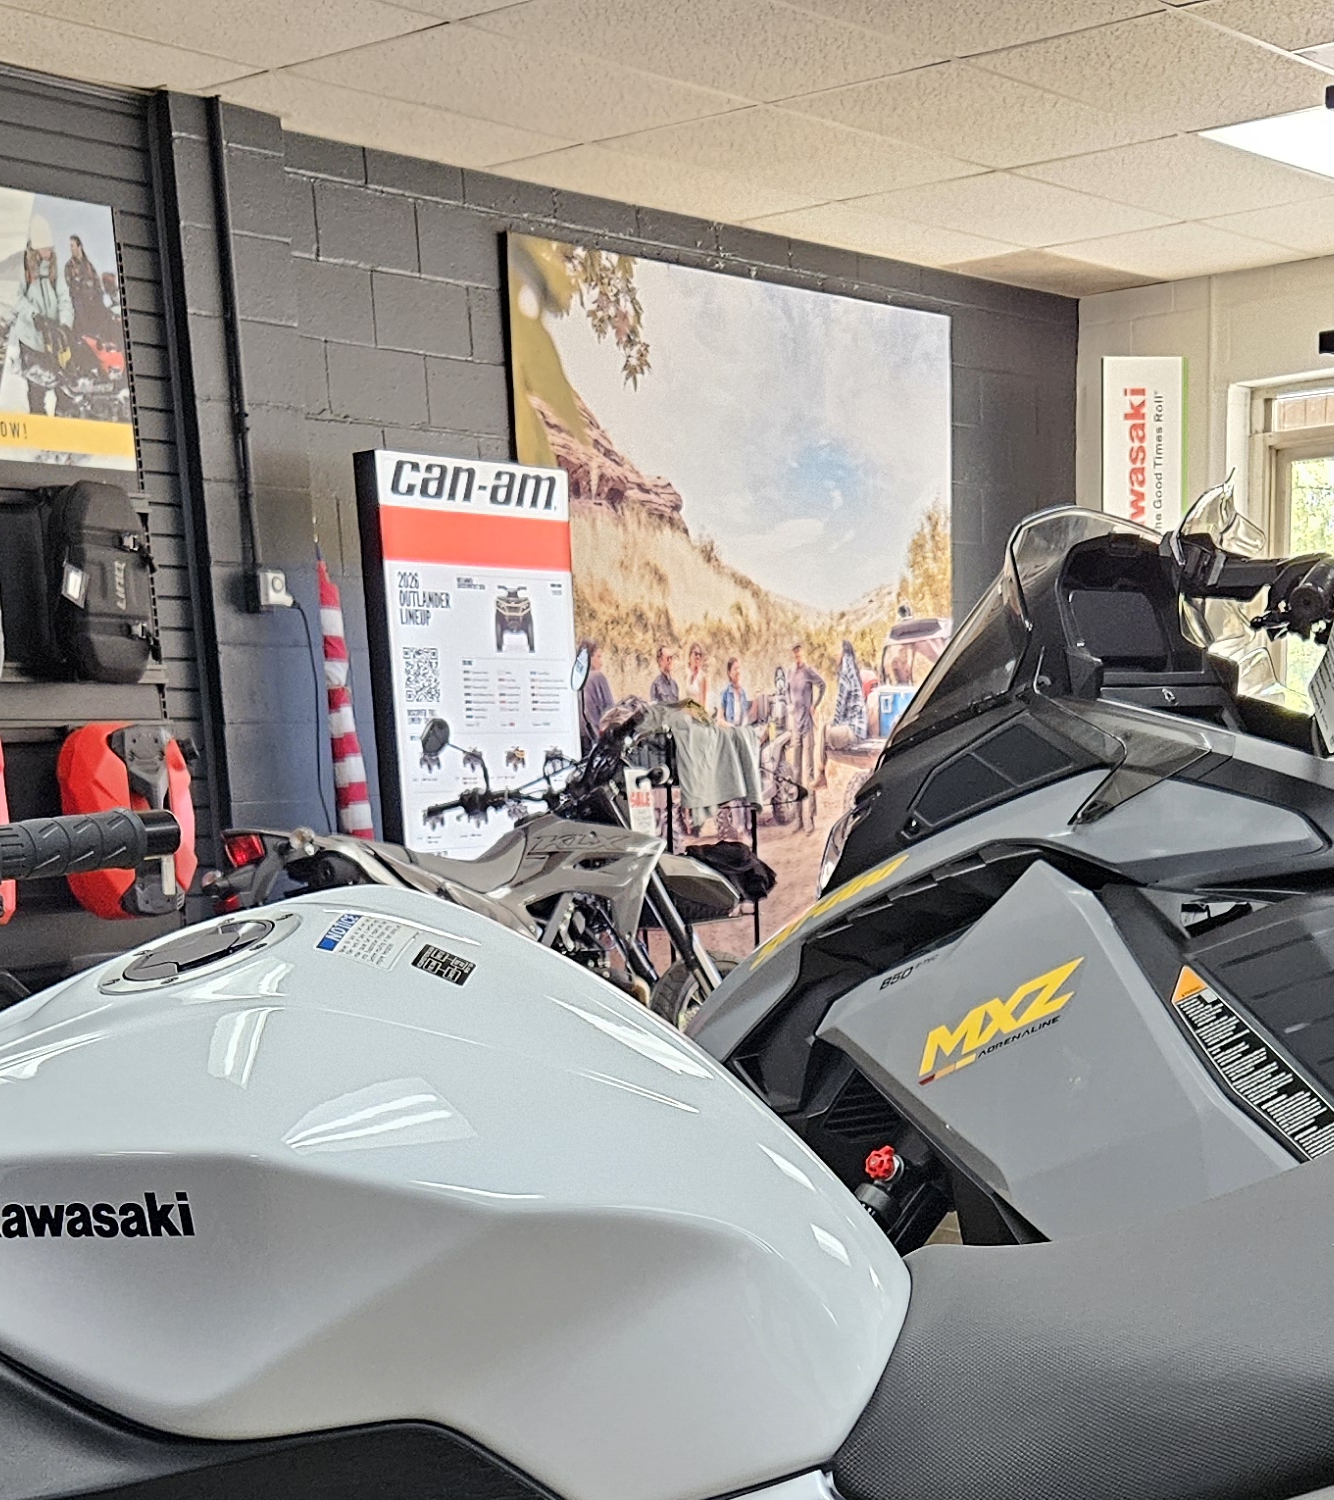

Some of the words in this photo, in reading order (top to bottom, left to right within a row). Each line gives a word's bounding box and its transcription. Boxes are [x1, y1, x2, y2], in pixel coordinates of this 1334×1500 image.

[1123, 387, 1148, 527] wasaki
[1153, 427, 1164, 466] Times
[390, 459, 557, 511] can-am
[1153, 469, 1164, 510] Good
[397, 571, 419, 589] 2026
[399, 590, 451, 609] OUTLANDER
[399, 608, 431, 626] LINEUP
[630, 791, 652, 808] SALE
[326, 914, 359, 942] NOTICE
[879, 966, 914, 991] 850
[918, 956, 1085, 1077] MXZ
[978, 1015, 1061, 1059] ADRENALINE
